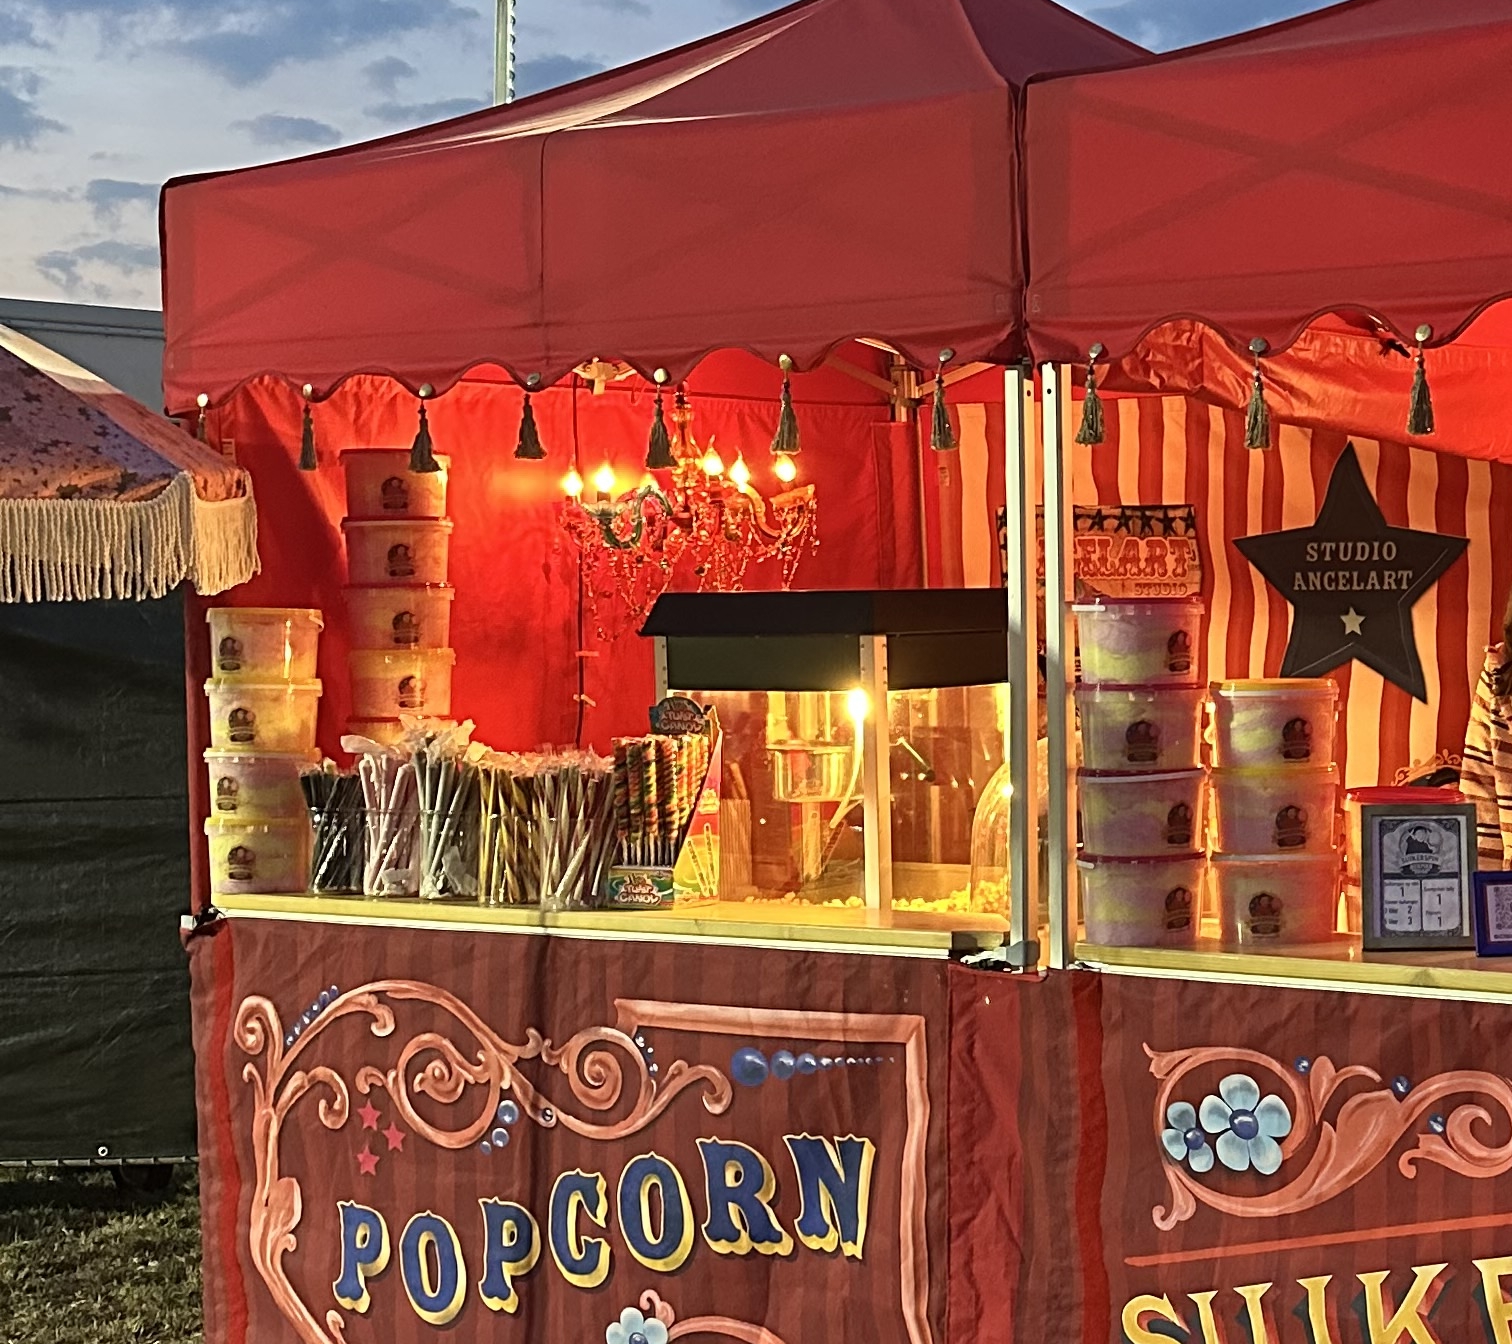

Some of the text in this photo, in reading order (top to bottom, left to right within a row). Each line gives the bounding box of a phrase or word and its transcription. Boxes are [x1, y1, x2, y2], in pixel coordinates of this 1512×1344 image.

[1305, 541, 1397, 562] STUDIO
[1134, 582, 1188, 596] STUDIO
[332, 1131, 876, 1325] POPCORN
